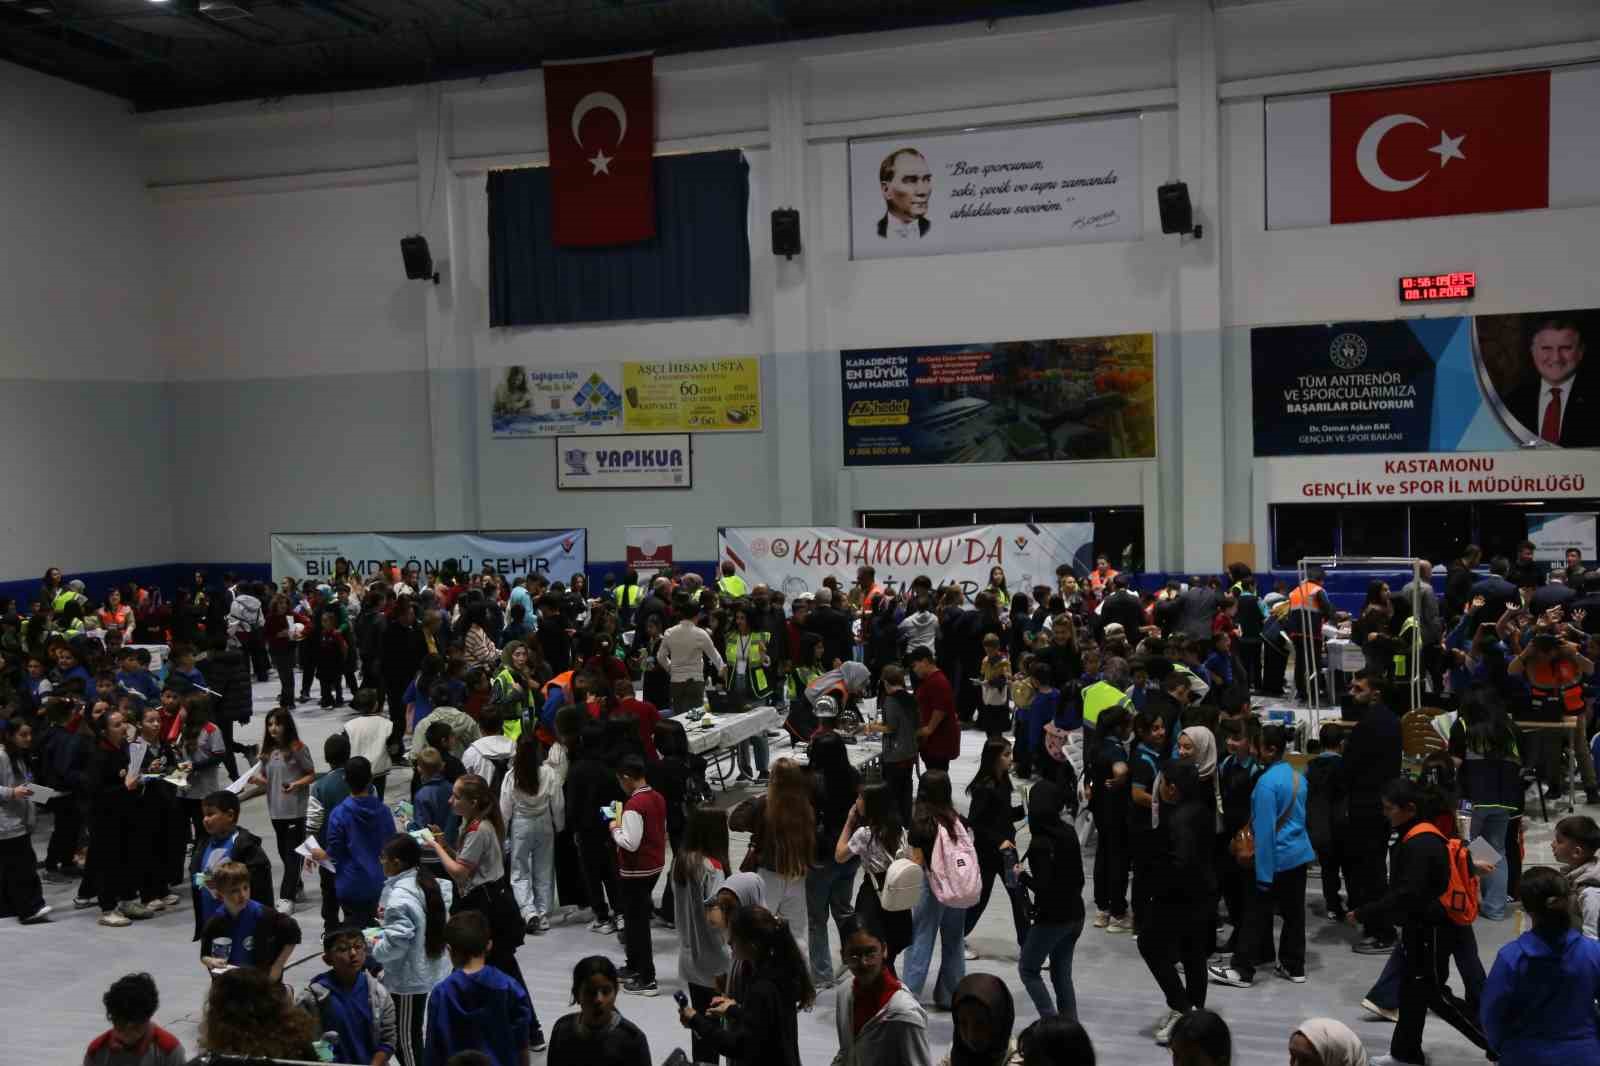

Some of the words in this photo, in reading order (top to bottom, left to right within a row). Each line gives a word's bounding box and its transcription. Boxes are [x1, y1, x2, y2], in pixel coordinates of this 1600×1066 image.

[1061, 168, 1119, 190] zamanda
[711, 359, 744, 371] USTA
[845, 370, 862, 381] EN
[864, 366, 908, 380] BÜYÜK
[1297, 374, 1327, 388] TÜM
[1329, 370, 1401, 386] ANTRENÖR
[847, 381, 868, 391] YAPI
[1283, 389, 1300, 401] VE
[1303, 385, 1417, 400] SPORCULARIMIZA
[1287, 401, 1348, 415] BAŞARILAR
[1350, 399, 1414, 411] DİLİYORUM
[1308, 424, 1321, 433] Dr.
[1321, 423, 1349, 433] Osman
[1373, 422, 1391, 431] BAK
[1298, 434, 1334, 446] GENÇLİK
[1335, 434, 1346, 443] VE
[1347, 433, 1370, 443] SPOR
[1370, 432, 1403, 442] BAKANI
[596, 449, 683, 467] YAPIKUR
[1384, 458, 1495, 474] KASTAMONU
[1302, 480, 1371, 499] GENÇLİK
[1376, 483, 1395, 495] ve
[1399, 479, 1444, 495] SPOR
[1448, 477, 1463, 493] İL
[1468, 474, 1585, 493] MÜDÜRLÜĞÜ
[793, 535, 1002, 566] KASTAMONU'DA
[306, 557, 399, 576] BİLMD
[405, 552, 473, 577] ÖNÜ
